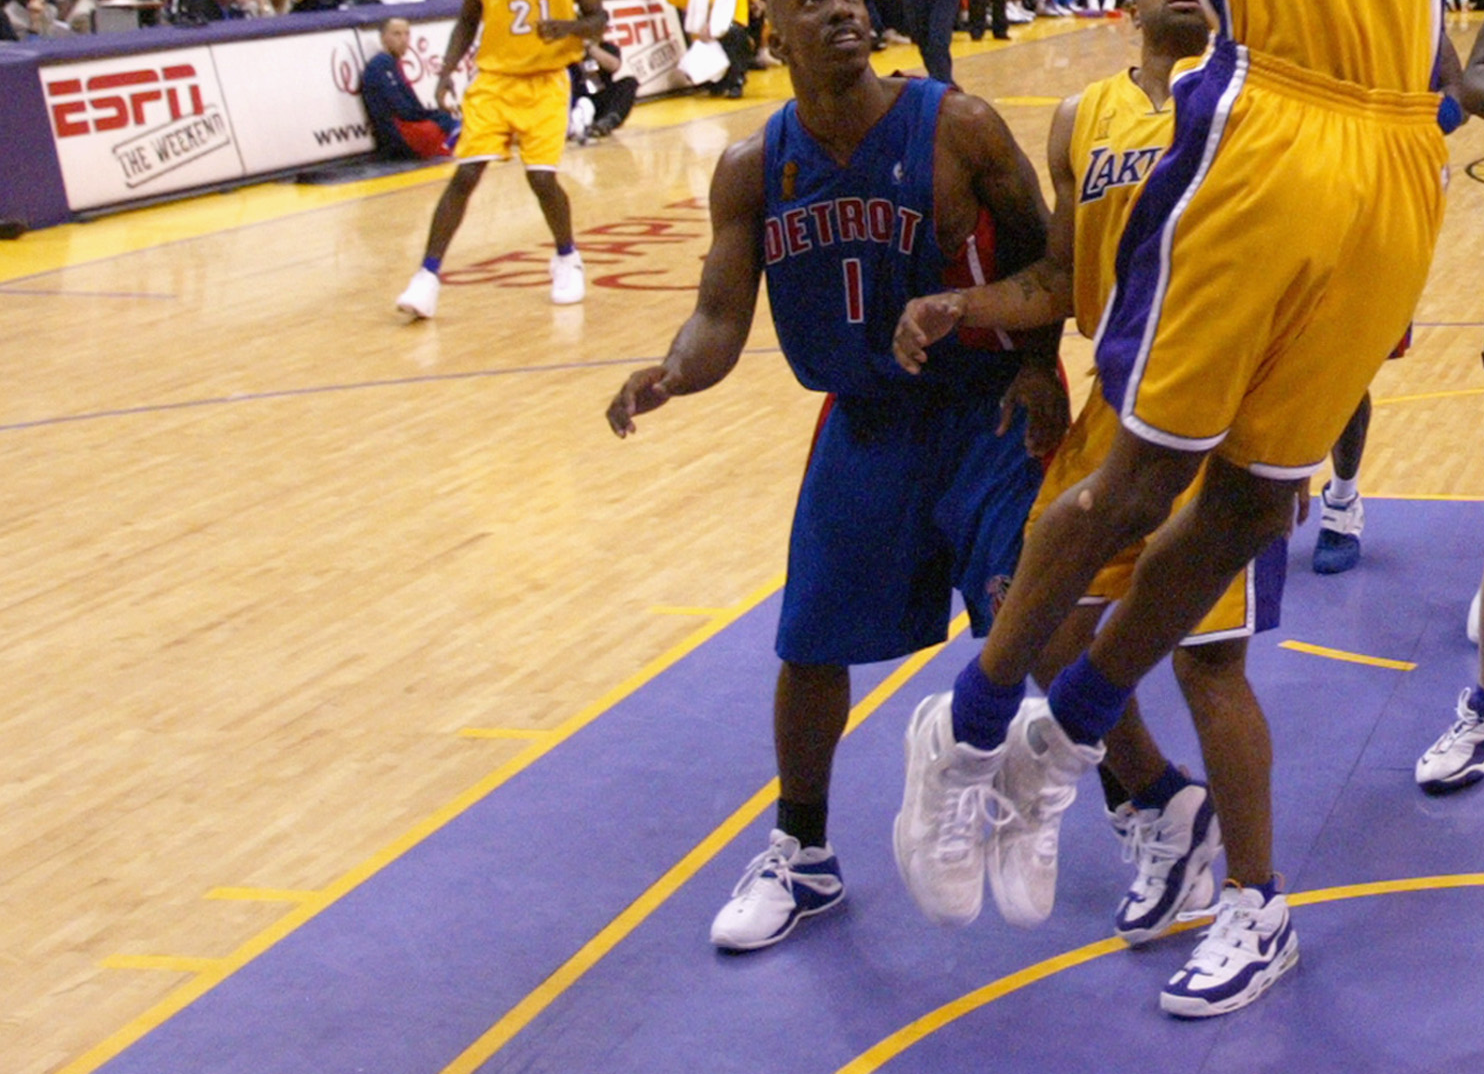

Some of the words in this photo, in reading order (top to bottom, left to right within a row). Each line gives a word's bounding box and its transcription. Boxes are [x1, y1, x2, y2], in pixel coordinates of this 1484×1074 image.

[47, 64, 205, 139] ESPN
[118, 145, 153, 178] THE
[151, 112, 227, 164] WEEKEND
[765, 196, 923, 266] DETROT
[842, 257, 864, 324] 1
